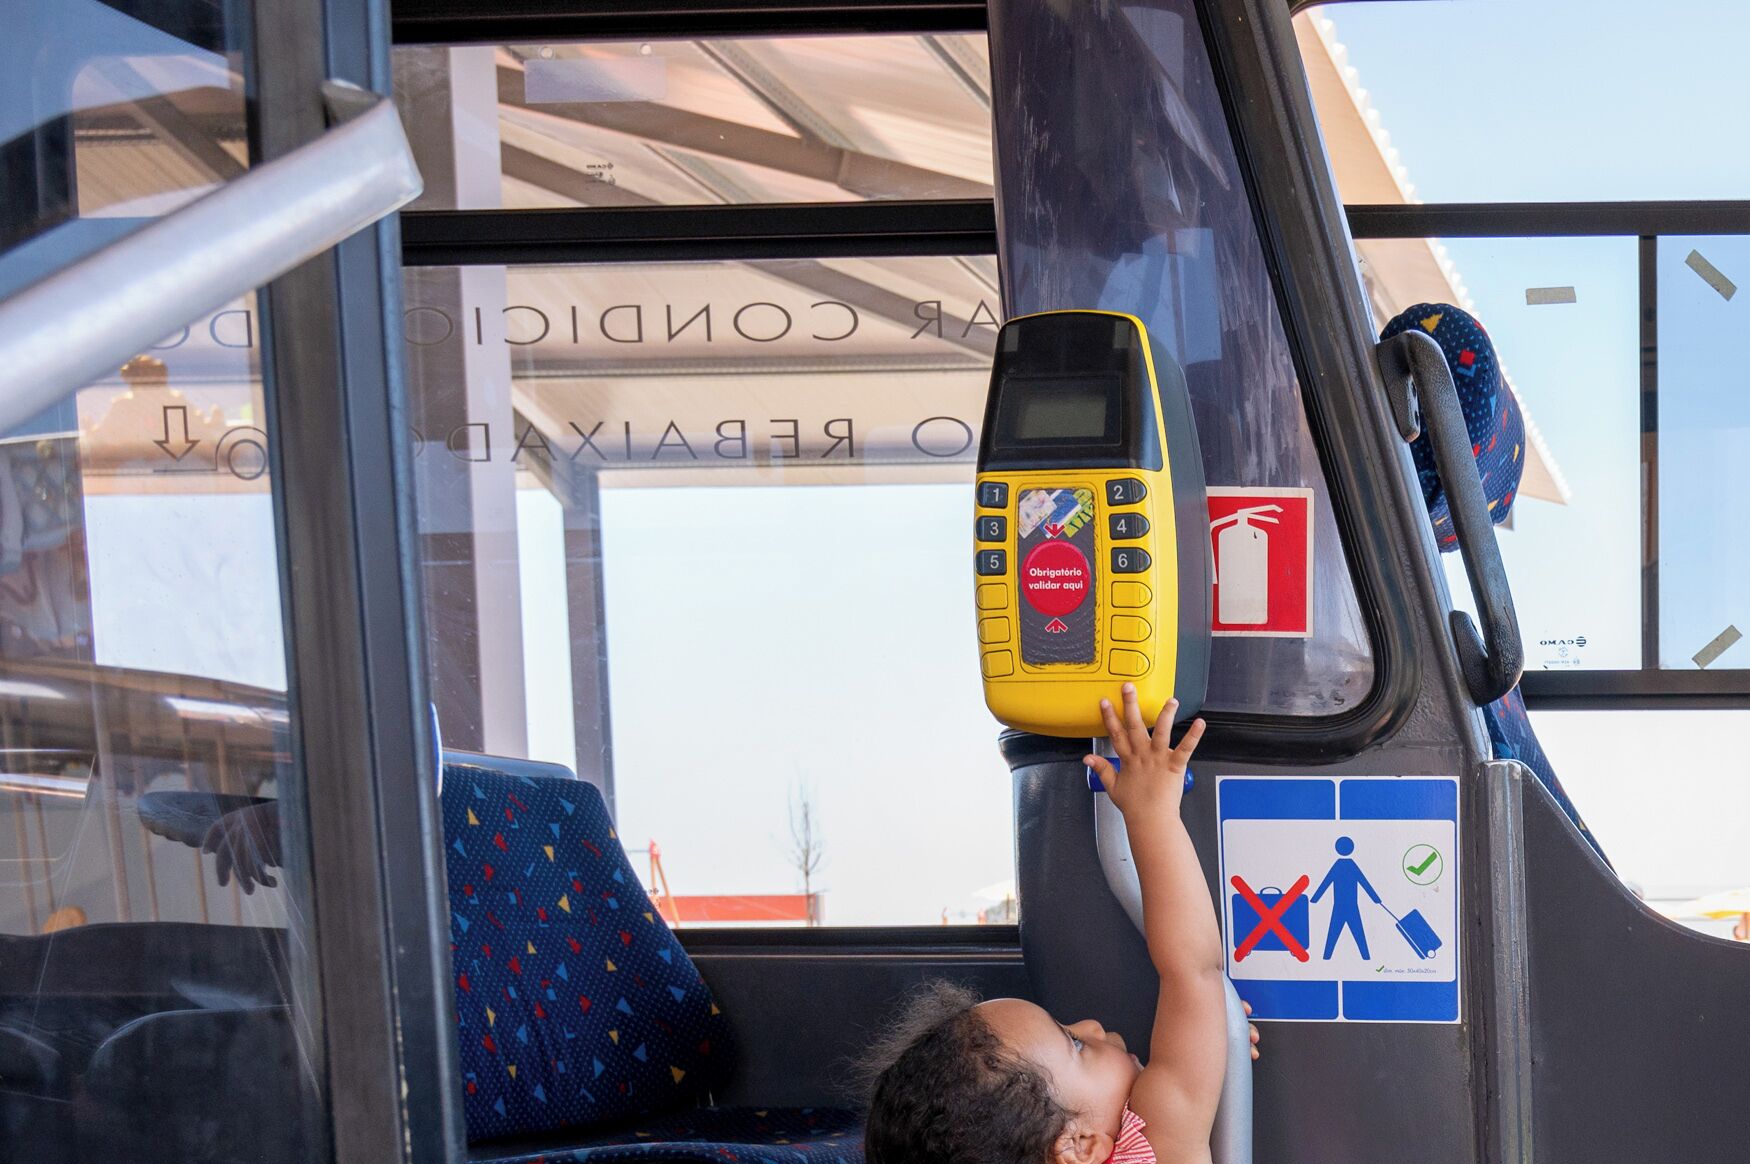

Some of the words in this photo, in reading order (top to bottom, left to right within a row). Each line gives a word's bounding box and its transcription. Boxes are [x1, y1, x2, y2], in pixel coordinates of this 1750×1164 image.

[993, 489, 1001, 501] 1
[1114, 486, 1124, 500] 2
[989, 521, 998, 535] 3
[1117, 520, 1127, 534] 4
[990, 555, 998, 568] 5
[1118, 554, 1127, 568] 6
[1029, 567, 1082, 578] Obrigatório
[1028, 580, 1061, 591] validar
[1063, 580, 1084, 592] aqui
